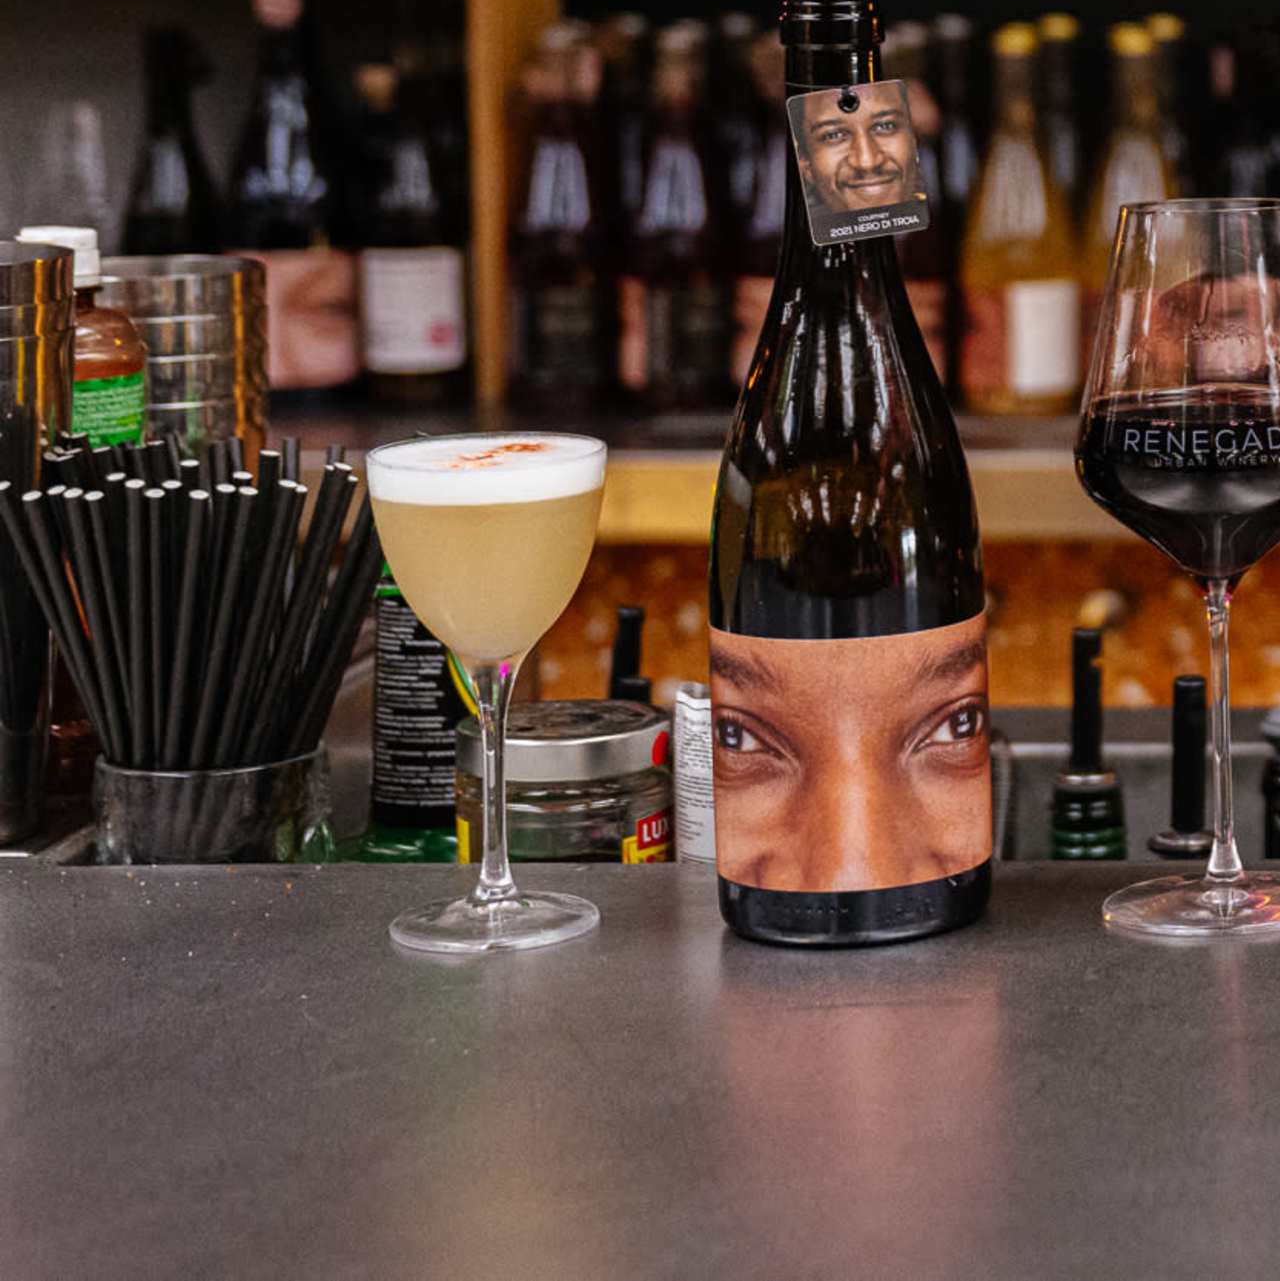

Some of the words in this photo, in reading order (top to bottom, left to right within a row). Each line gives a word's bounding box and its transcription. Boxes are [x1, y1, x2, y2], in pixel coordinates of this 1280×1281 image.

[829, 224, 853, 238] 2021
[854, 220, 881, 234] NERO
[881, 218, 892, 230] DI
[892, 214, 920, 227] TROIA
[1153, 457, 1208, 468] URBAN
[1217, 455, 1279, 467] WINERY
